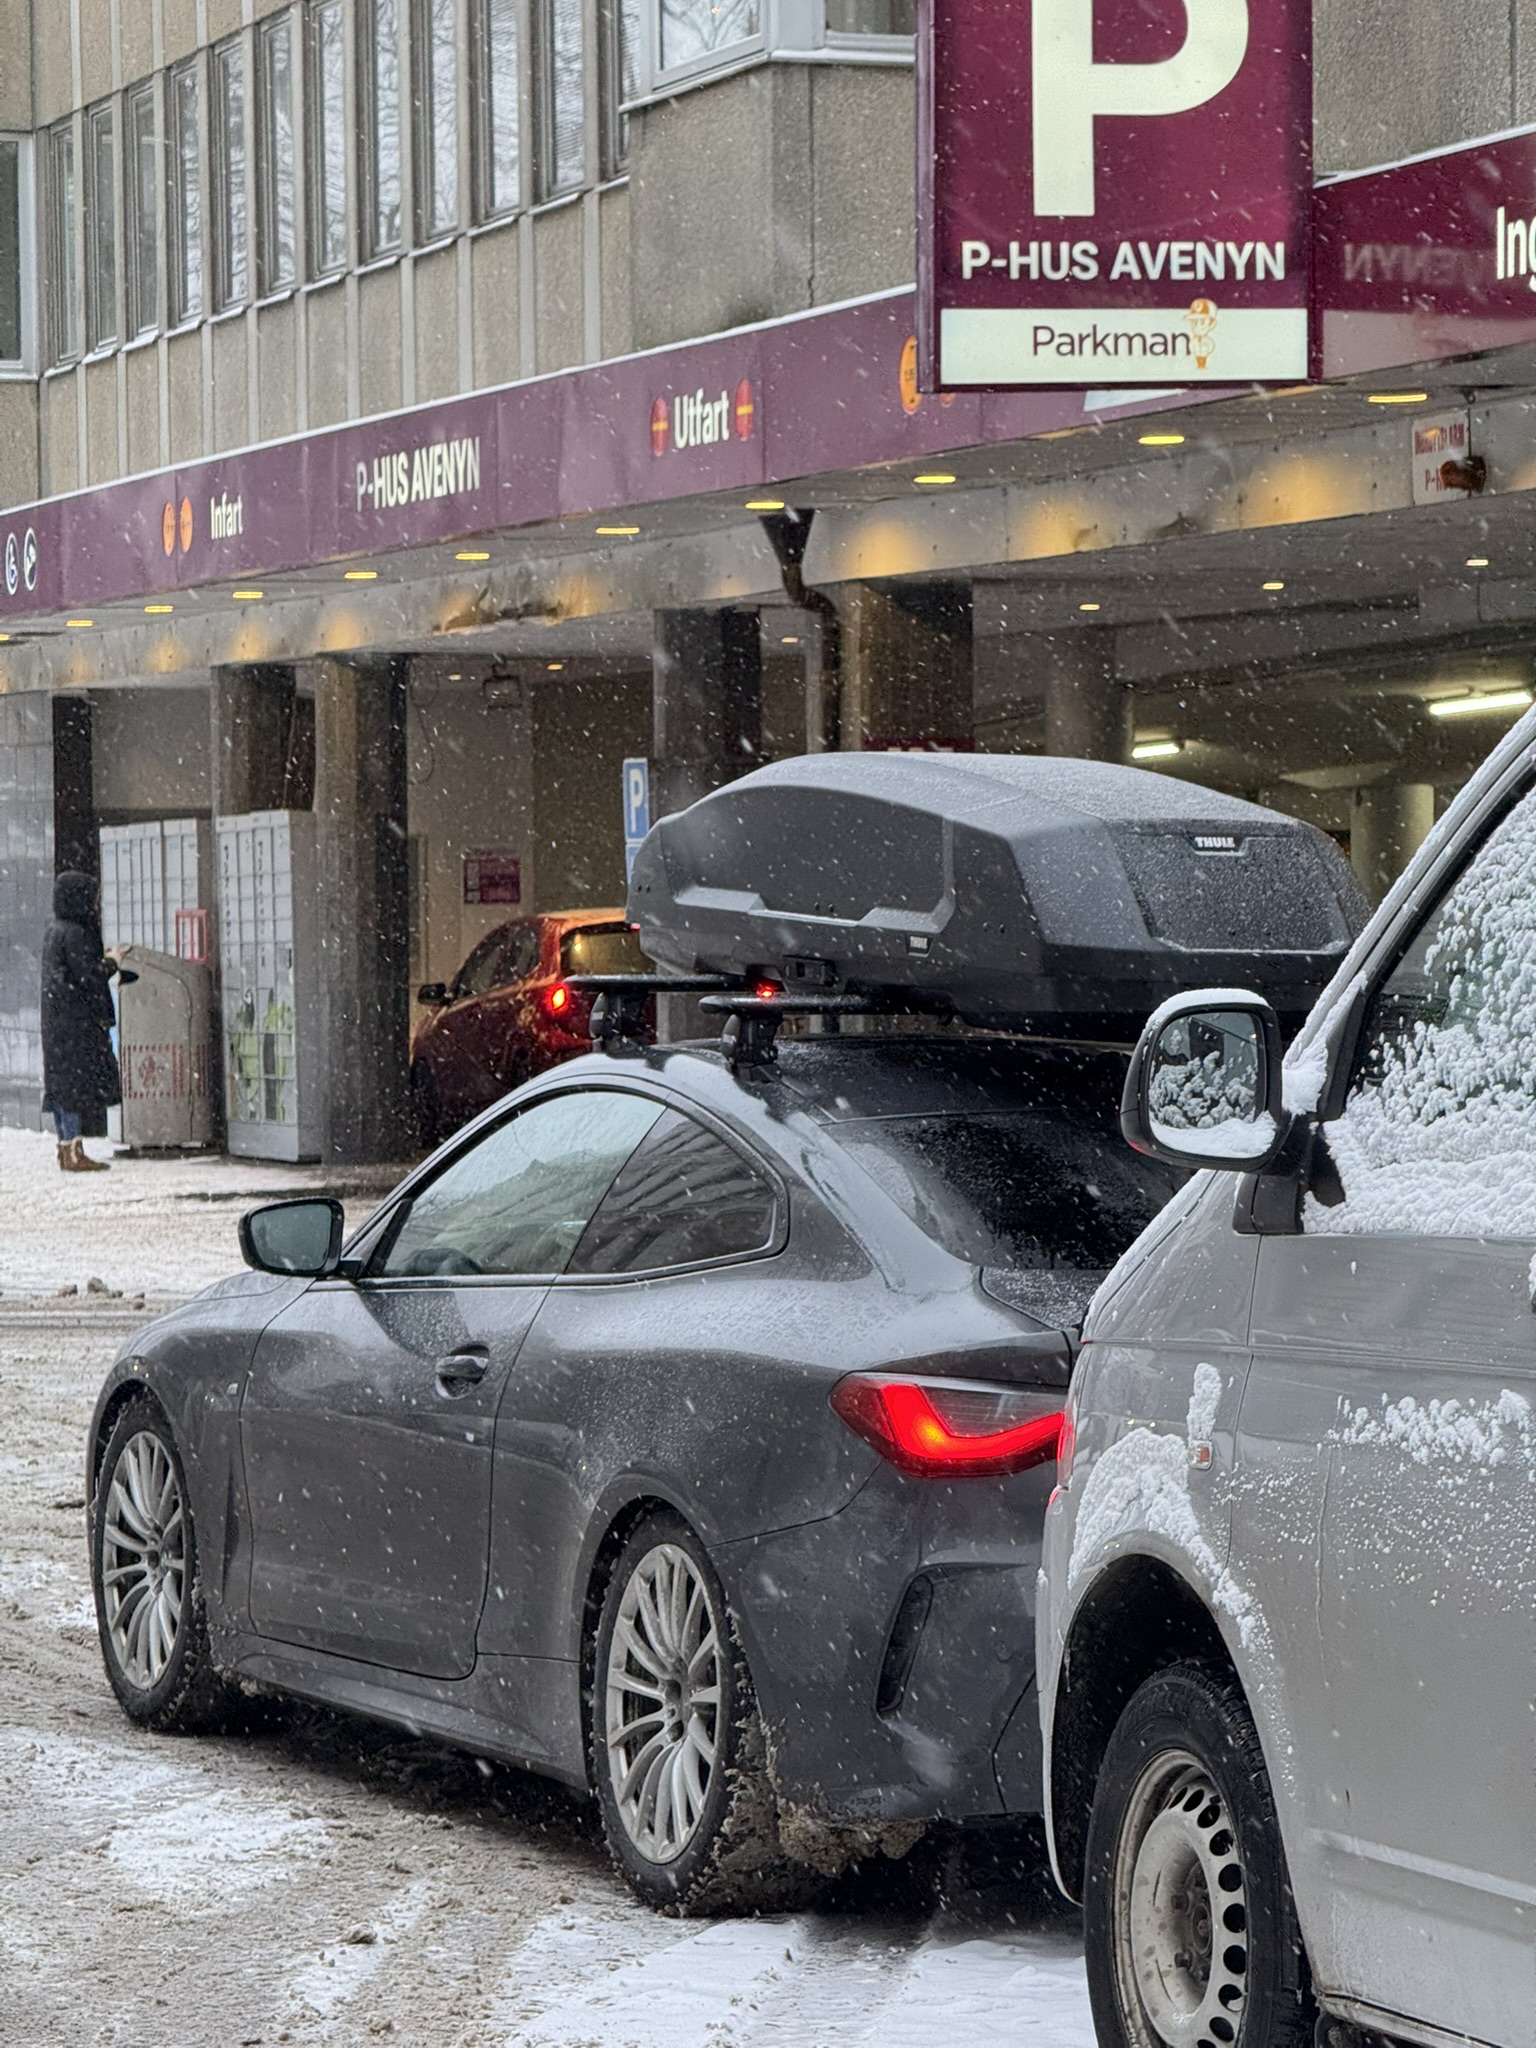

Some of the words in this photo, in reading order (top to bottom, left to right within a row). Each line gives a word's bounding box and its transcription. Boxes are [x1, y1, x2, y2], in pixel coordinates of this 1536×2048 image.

[1033, 0, 1249, 217] P
[961, 241, 1100, 281] P-HUS
[1109, 241, 1286, 281] AVENYN
[1032, 324, 1192, 358] Parkman
[674, 387, 730, 449] Utfart
[356, 451, 409, 512] P-HUS
[411, 436, 480, 502] AVENYN
[210, 491, 243, 540] Infart
[629, 768, 645, 833] P
[1194, 836, 1235, 848] THULE
